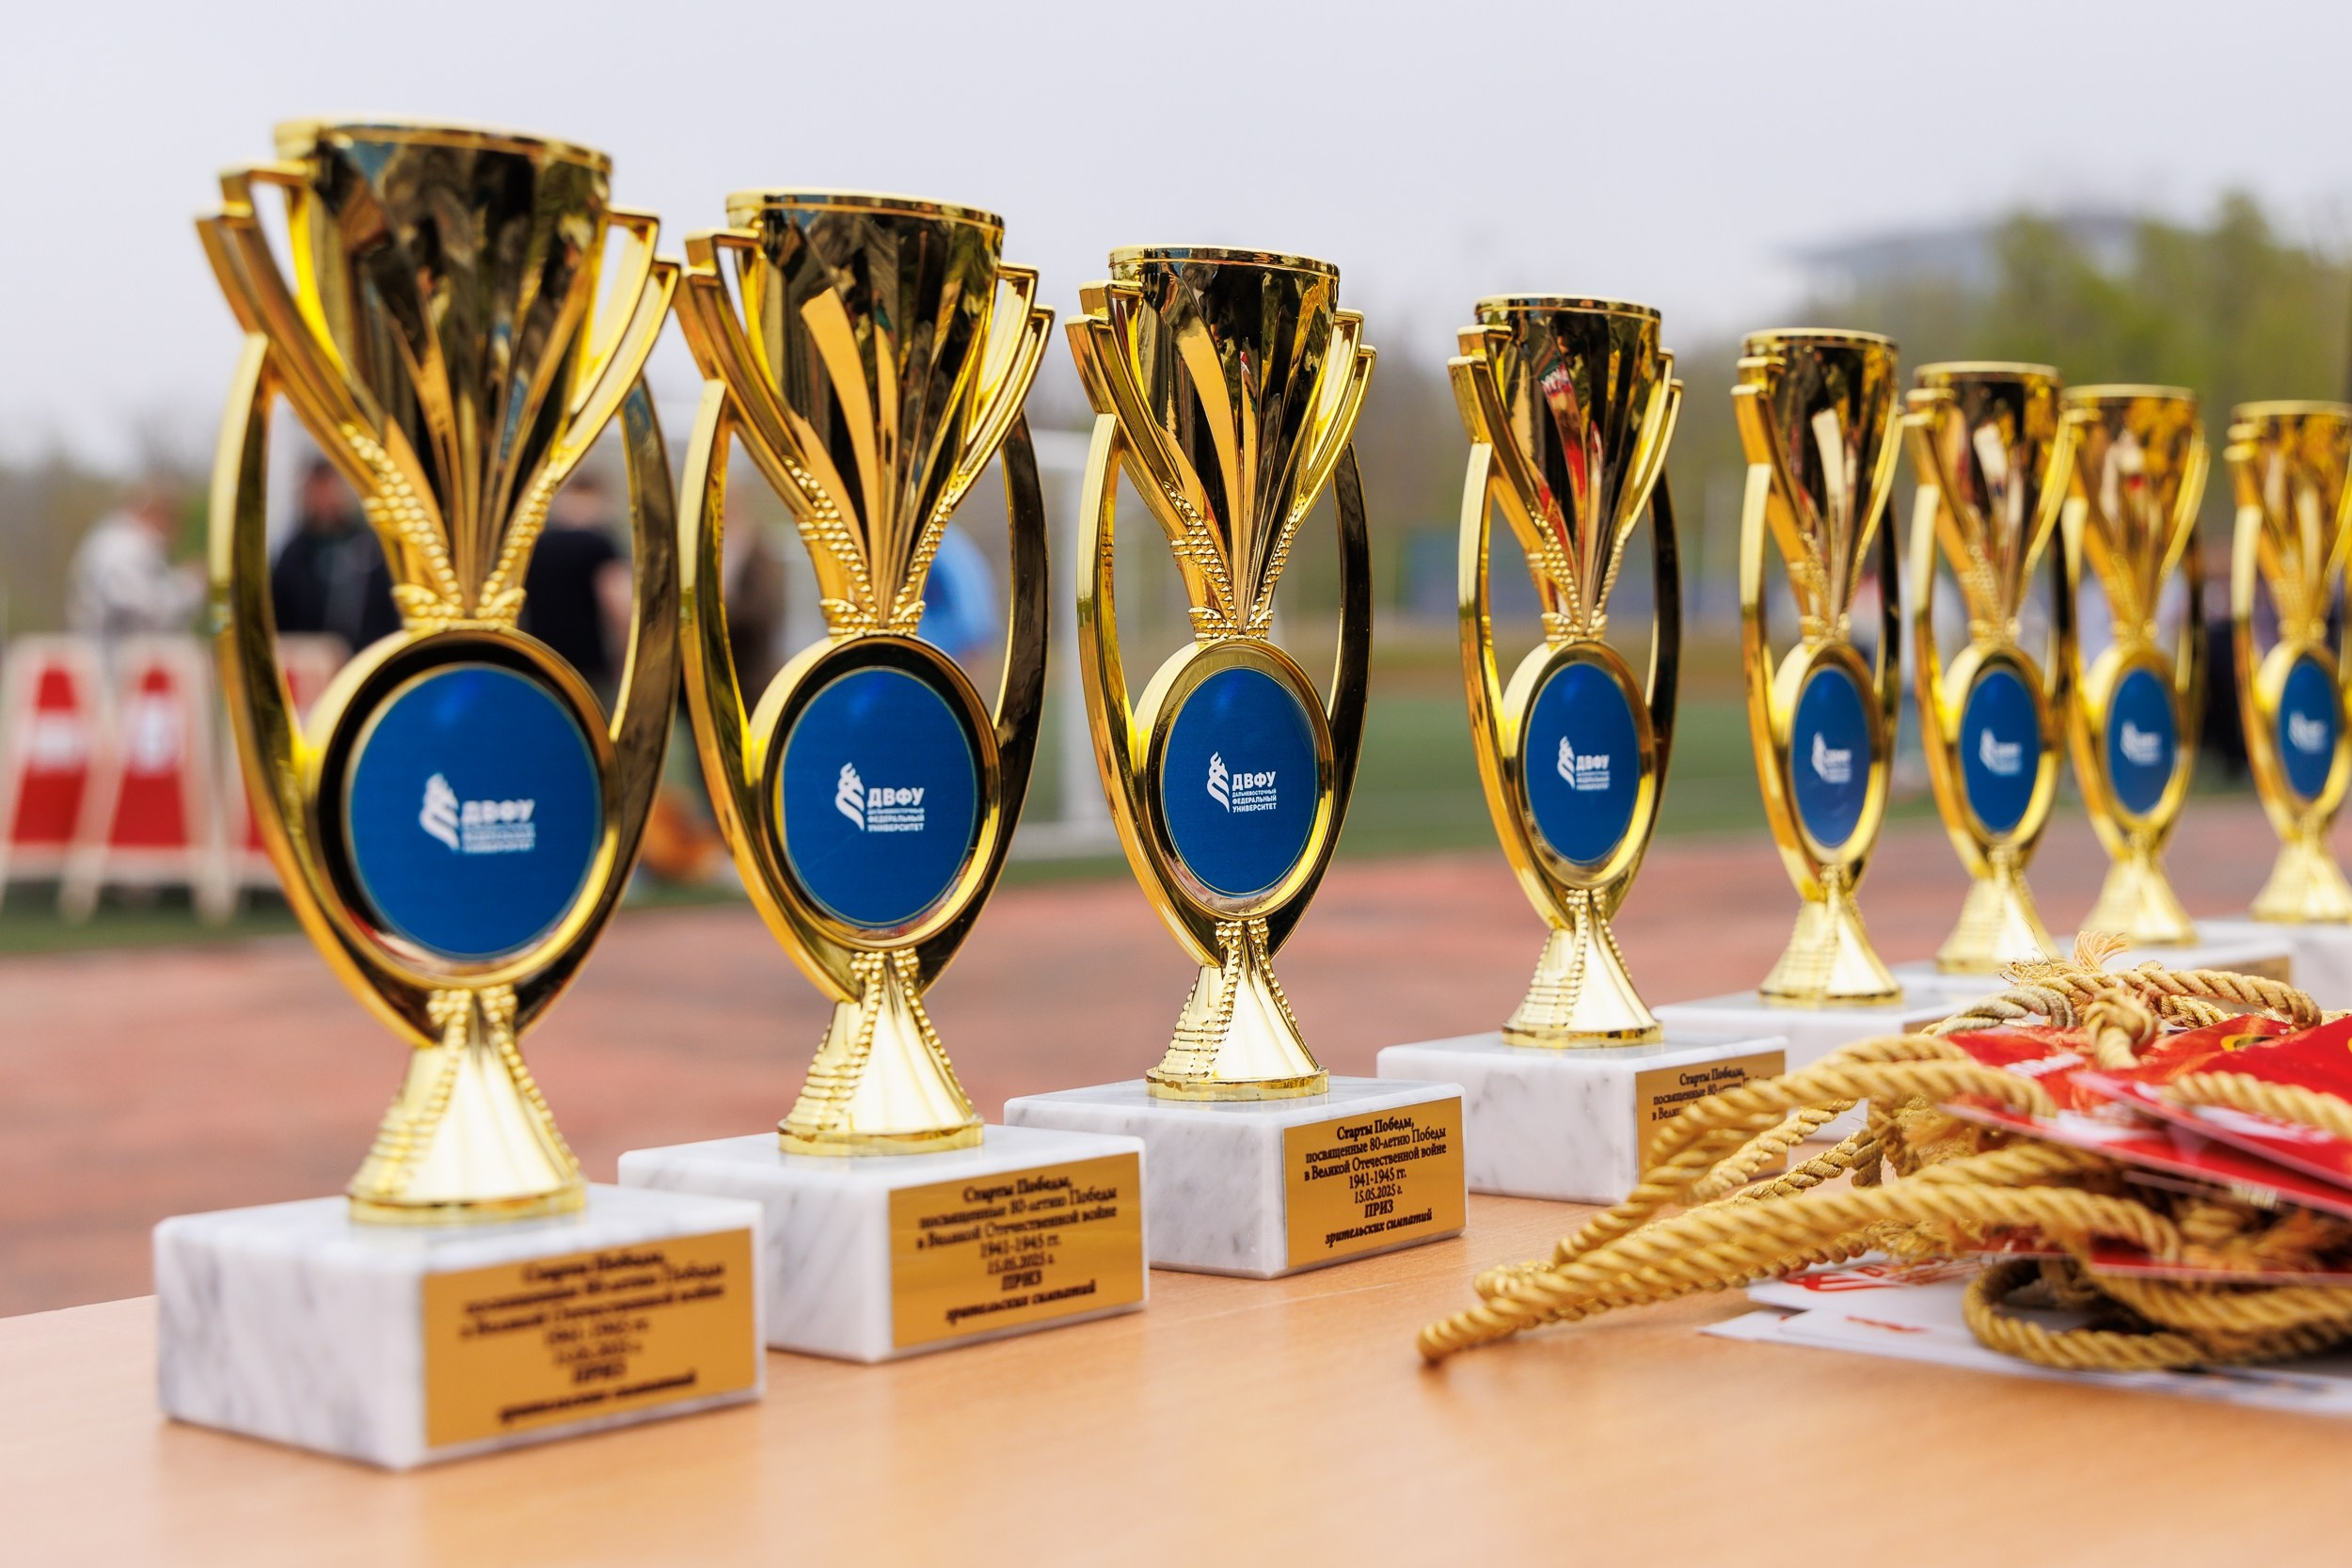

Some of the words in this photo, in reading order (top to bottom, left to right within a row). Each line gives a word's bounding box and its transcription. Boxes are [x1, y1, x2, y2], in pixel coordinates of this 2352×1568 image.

[1232, 771, 1276, 791] ДВФУ
[866, 787, 925, 808] ДВФУ
[1232, 788, 1277, 798] ДАЛЬНЕВОСТОЧНЫЙ
[1232, 794, 1277, 804] ФЕДЕРАЛЬНЫЙ
[1232, 802, 1277, 813] УНИВЕРСИТЕТ
[1679, 1071, 1710, 1086] Старты
[1653, 1086, 1706, 1105] посвященные
[1652, 1111, 1657, 1121] в
[1337, 1124, 1374, 1142] Старты
[1375, 1117, 1414, 1133] Победы,
[1306, 1142, 1368, 1164] посвященные
[1370, 1134, 1410, 1151] 80-летию
[1412, 1127, 1447, 1144] Победы
[1304, 1170, 1310, 1181] в
[1311, 1160, 1351, 1180] Великой
[1352, 1147, 1420, 1172] Отечественной
[1421, 1143, 1447, 1158] войне
[1349, 1168, 1394, 1189] 1941-1945
[1396, 1168, 1406, 1180] гг.
[962, 1183, 1013, 1204] Старты
[1017, 1175, 1073, 1196] Победы,
[1070, 1185, 1118, 1205] Победы
[1355, 1184, 1396, 1204] 15.05.2025
[1397, 1185, 1403, 1195] г.
[1364, 1199, 1394, 1218] ПРИЗ
[1325, 1222, 1385, 1248] зрительских
[1386, 1208, 1433, 1230] симпатий
[1001, 1270, 1042, 1291] ПРИЗ
